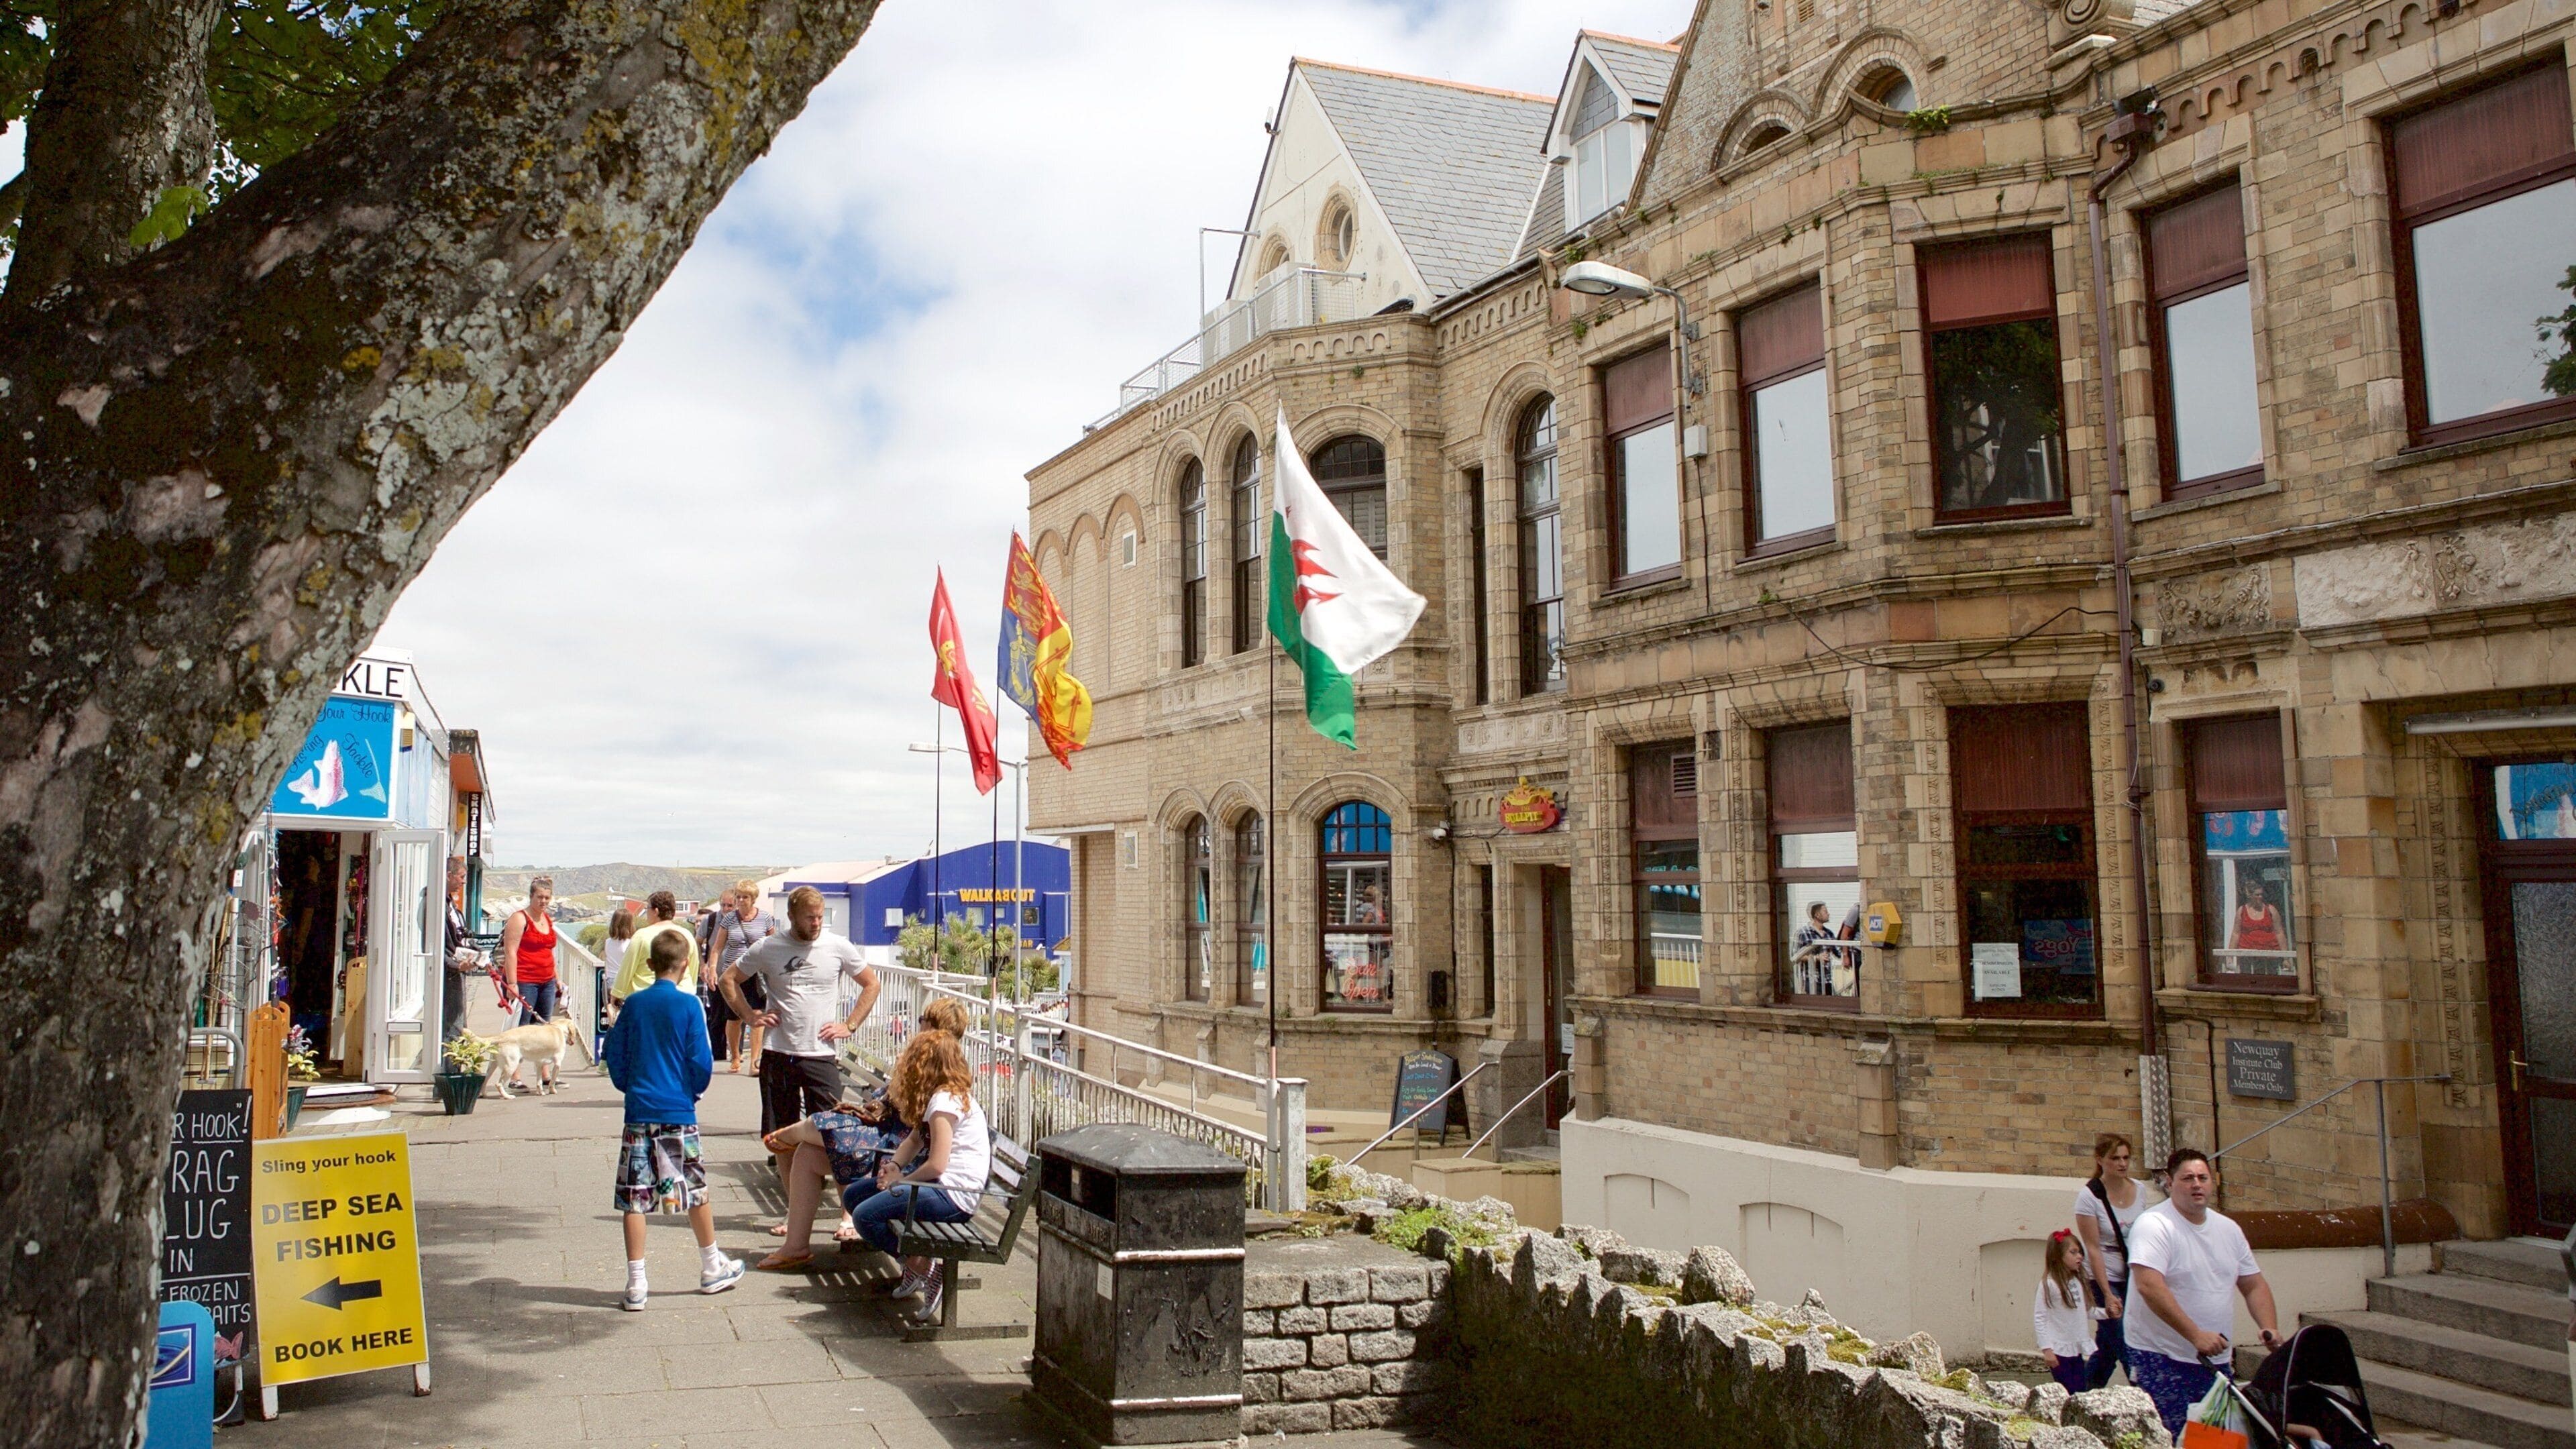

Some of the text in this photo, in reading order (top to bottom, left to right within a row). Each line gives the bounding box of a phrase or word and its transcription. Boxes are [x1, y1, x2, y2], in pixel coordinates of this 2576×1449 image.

[335, 663, 405, 698] KLE
[350, 702, 391, 723] Hook
[342, 733, 374, 779] Tackle
[470, 794, 479, 856] SKATESHOP
[959, 888, 1036, 902] WALKABOUT
[1869, 918, 1882, 929] ADT
[1342, 977, 1379, 1003] Open
[2233, 1041, 2280, 1059] Newquay
[2232, 1056, 2283, 1070] Institute Club
[2239, 1067, 2277, 1082] Private
[2233, 1079, 2285, 1094] Members Only
[172, 1150, 239, 1193] RAG
[262, 1150, 396, 1174] Sling your hook
[261, 1192, 404, 1226] DEEP SEA
[276, 1230, 396, 1262] FISHING
[170, 1248, 193, 1273] IN
[170, 1280, 239, 1302] FROZEN
[275, 1327, 413, 1363] BOOK HERE
